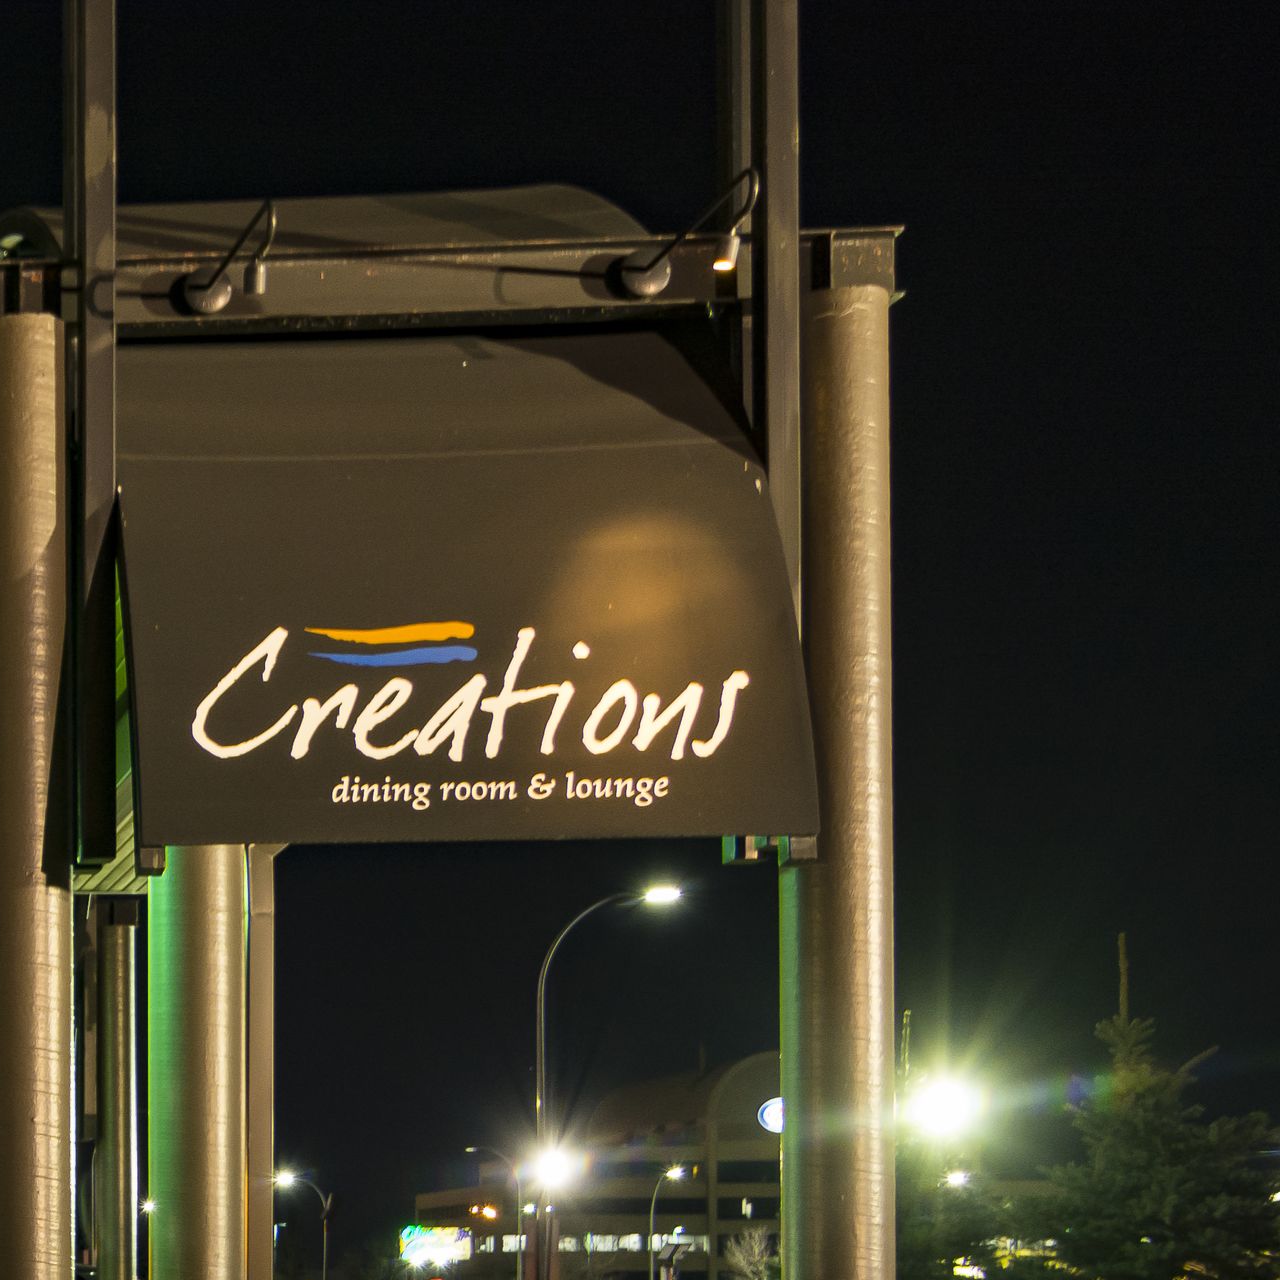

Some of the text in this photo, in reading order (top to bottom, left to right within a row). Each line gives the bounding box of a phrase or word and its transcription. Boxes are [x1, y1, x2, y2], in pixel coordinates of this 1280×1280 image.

[192, 626, 750, 762] Creations
[331, 772, 670, 810] dining room & lounge
